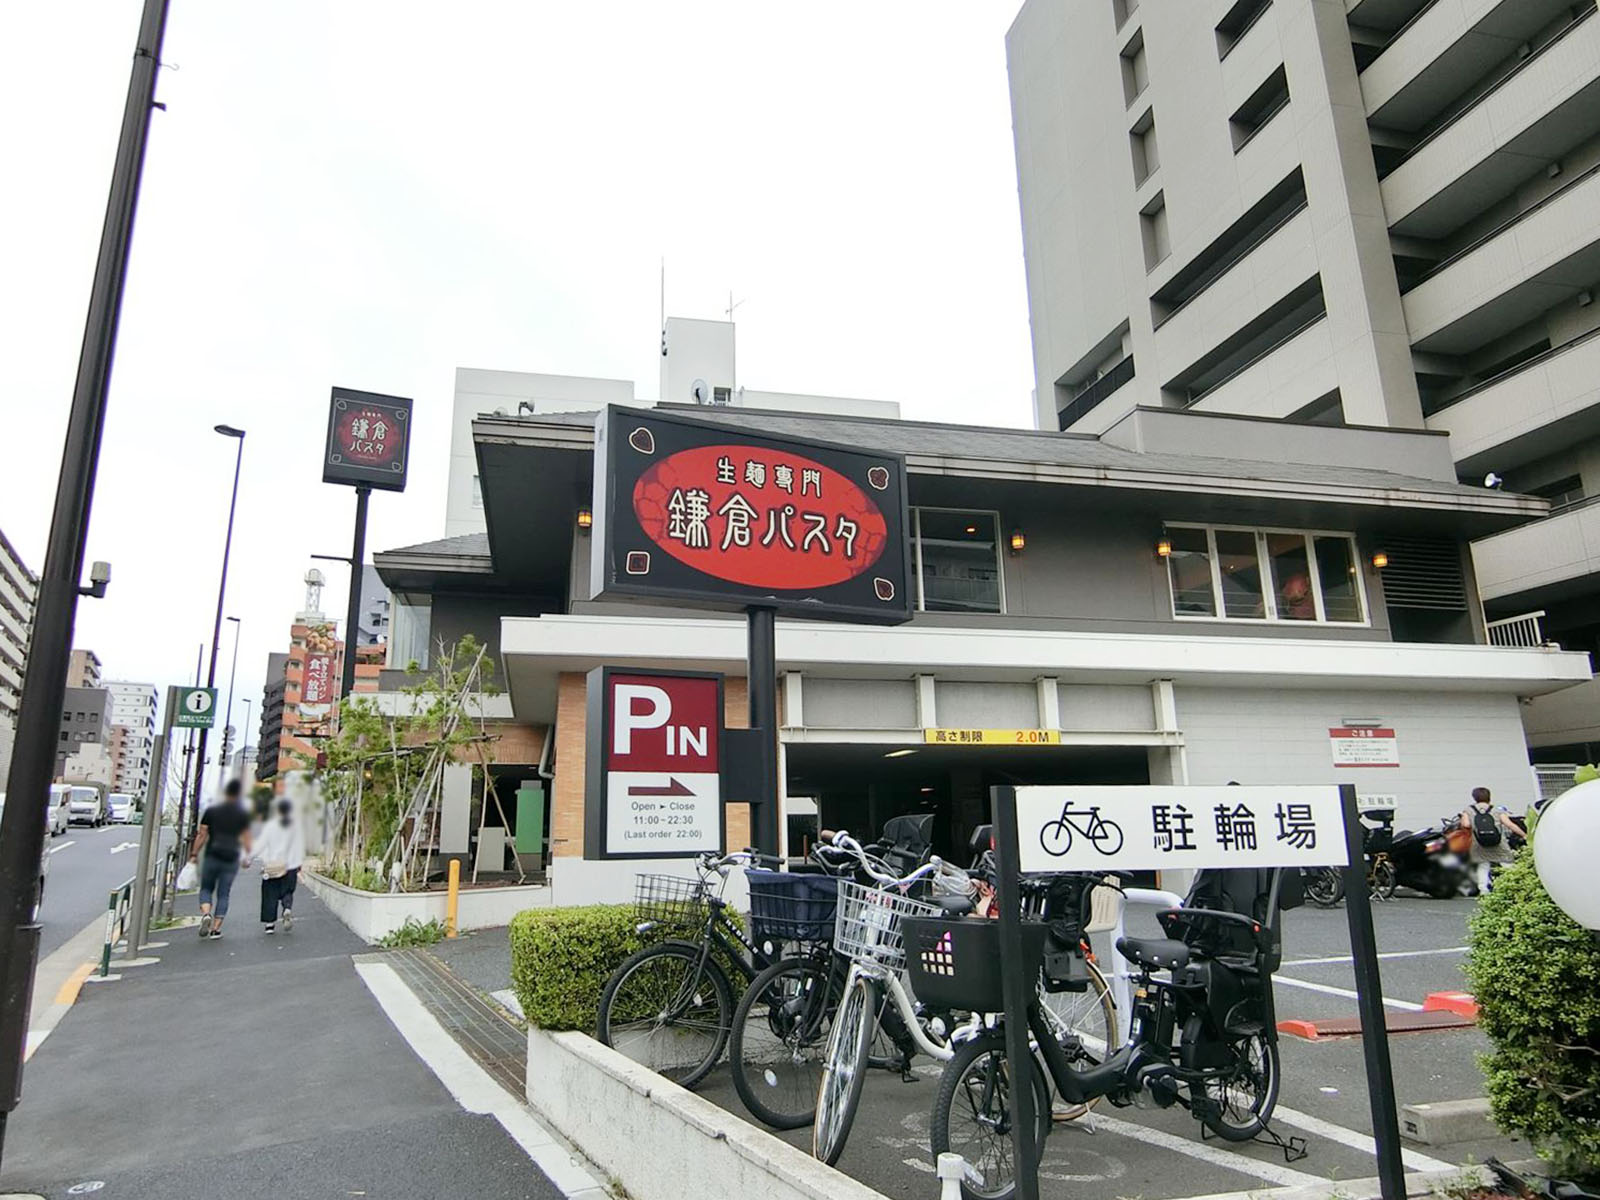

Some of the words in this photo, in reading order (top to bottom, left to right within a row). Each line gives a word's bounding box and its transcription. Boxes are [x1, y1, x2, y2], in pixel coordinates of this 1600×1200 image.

[668, 489, 858, 556] 鎌倉パスタ
[614, 684, 672, 754] P
[667, 726, 708, 757] IN
[936, 730, 983, 742] 高さ制限
[1016, 731, 1049, 743] 2.0M
[631, 801, 656, 812] Open
[669, 801, 695, 811] Close
[624, 830, 647, 840] (Last
[649, 830, 671, 839] order
[676, 829, 703, 840] 22:00)
[1151, 802, 1317, 852] 駐輪場
